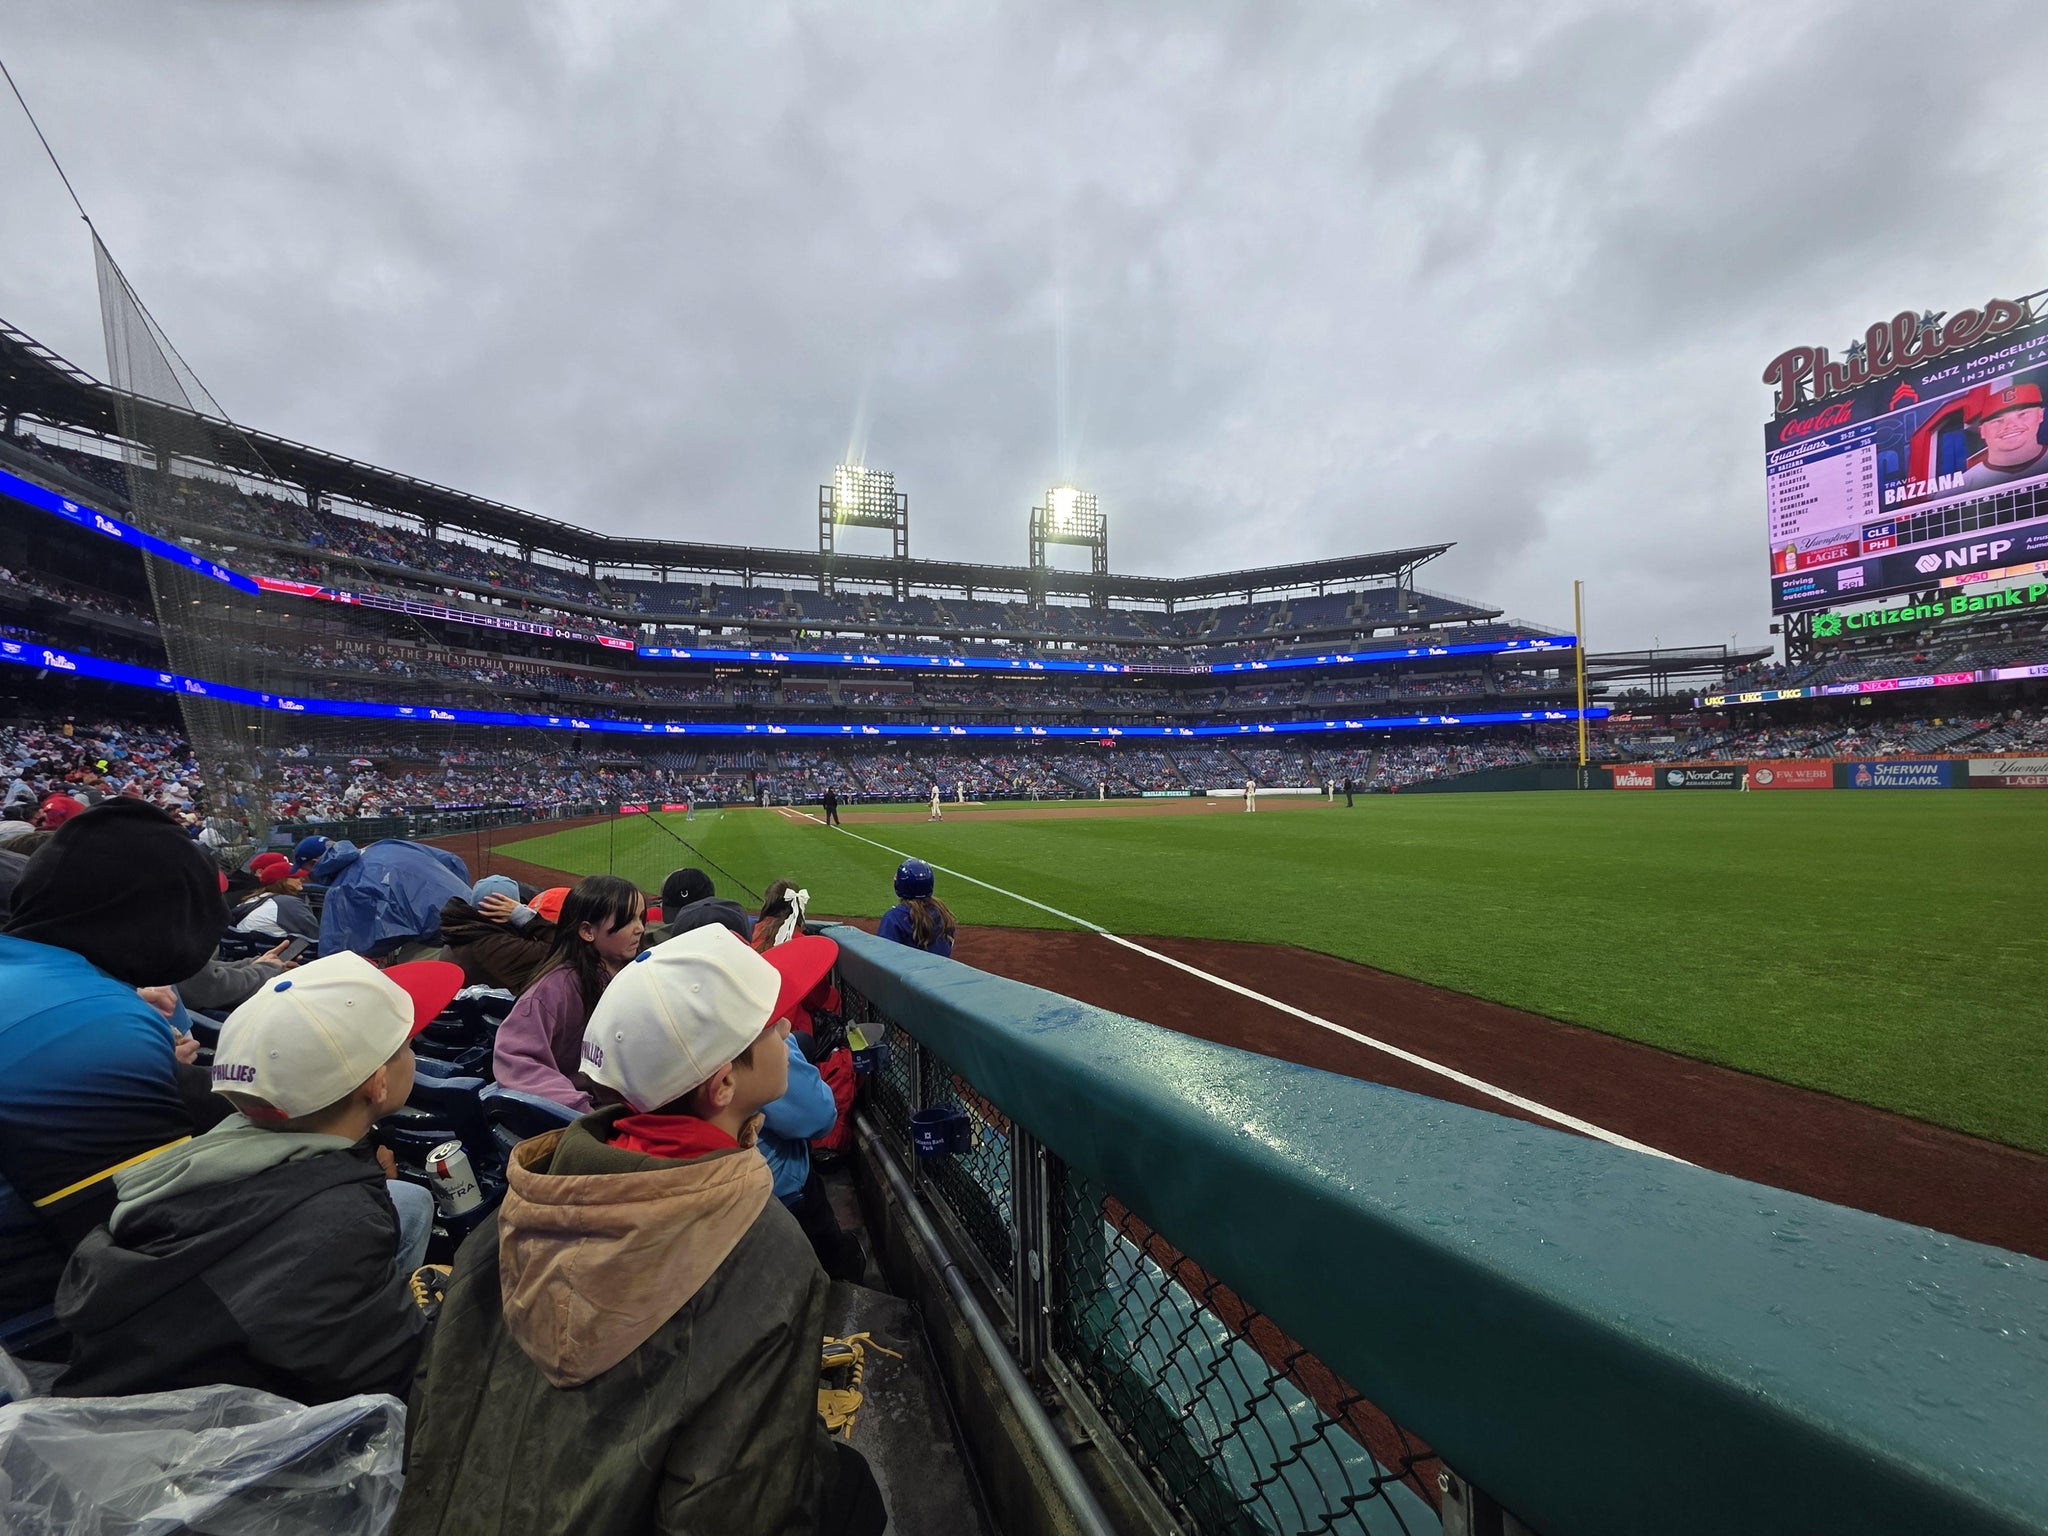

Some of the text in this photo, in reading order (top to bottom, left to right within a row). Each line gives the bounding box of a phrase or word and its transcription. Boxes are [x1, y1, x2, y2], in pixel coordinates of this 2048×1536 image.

[1763, 298, 2023, 413] Phillies
[1921, 334, 2048, 386] SALTZ MONGELUZ
[1961, 360, 2016, 384] INJURY
[1780, 401, 1855, 442] Coca-Cola
[1771, 440, 1830, 463] Guardians
[1884, 476, 1916, 489] TRAVIS
[1884, 471, 1965, 505] BAZZANA
[1867, 526, 1889, 538] CLE
[1869, 539, 1889, 551] PHI
[1806, 548, 1849, 565] LAGER
[1945, 539, 2012, 569] NFP
[1783, 577, 1814, 588] Driving
[1783, 584, 1817, 594] smarter
[1783, 589, 1828, 600] outcomes.
[1846, 600, 1945, 629] Citizens
[1950, 587, 2024, 614] Bank
[400, 648, 420, 660] THE
[1862, 681, 1896, 691] NECA
[1936, 674, 1973, 684] NECA
[1704, 689, 1802, 705] UKG UKG UKG
[1686, 769, 1734, 780] NovaCare
[1796, 769, 1826, 778] WEBB
[1874, 764, 1938, 775] SHERWIN
[1615, 775, 1653, 787] Wawa
[2005, 776, 2048, 785] LAGE
[213, 1063, 257, 1083] PHILLIES
